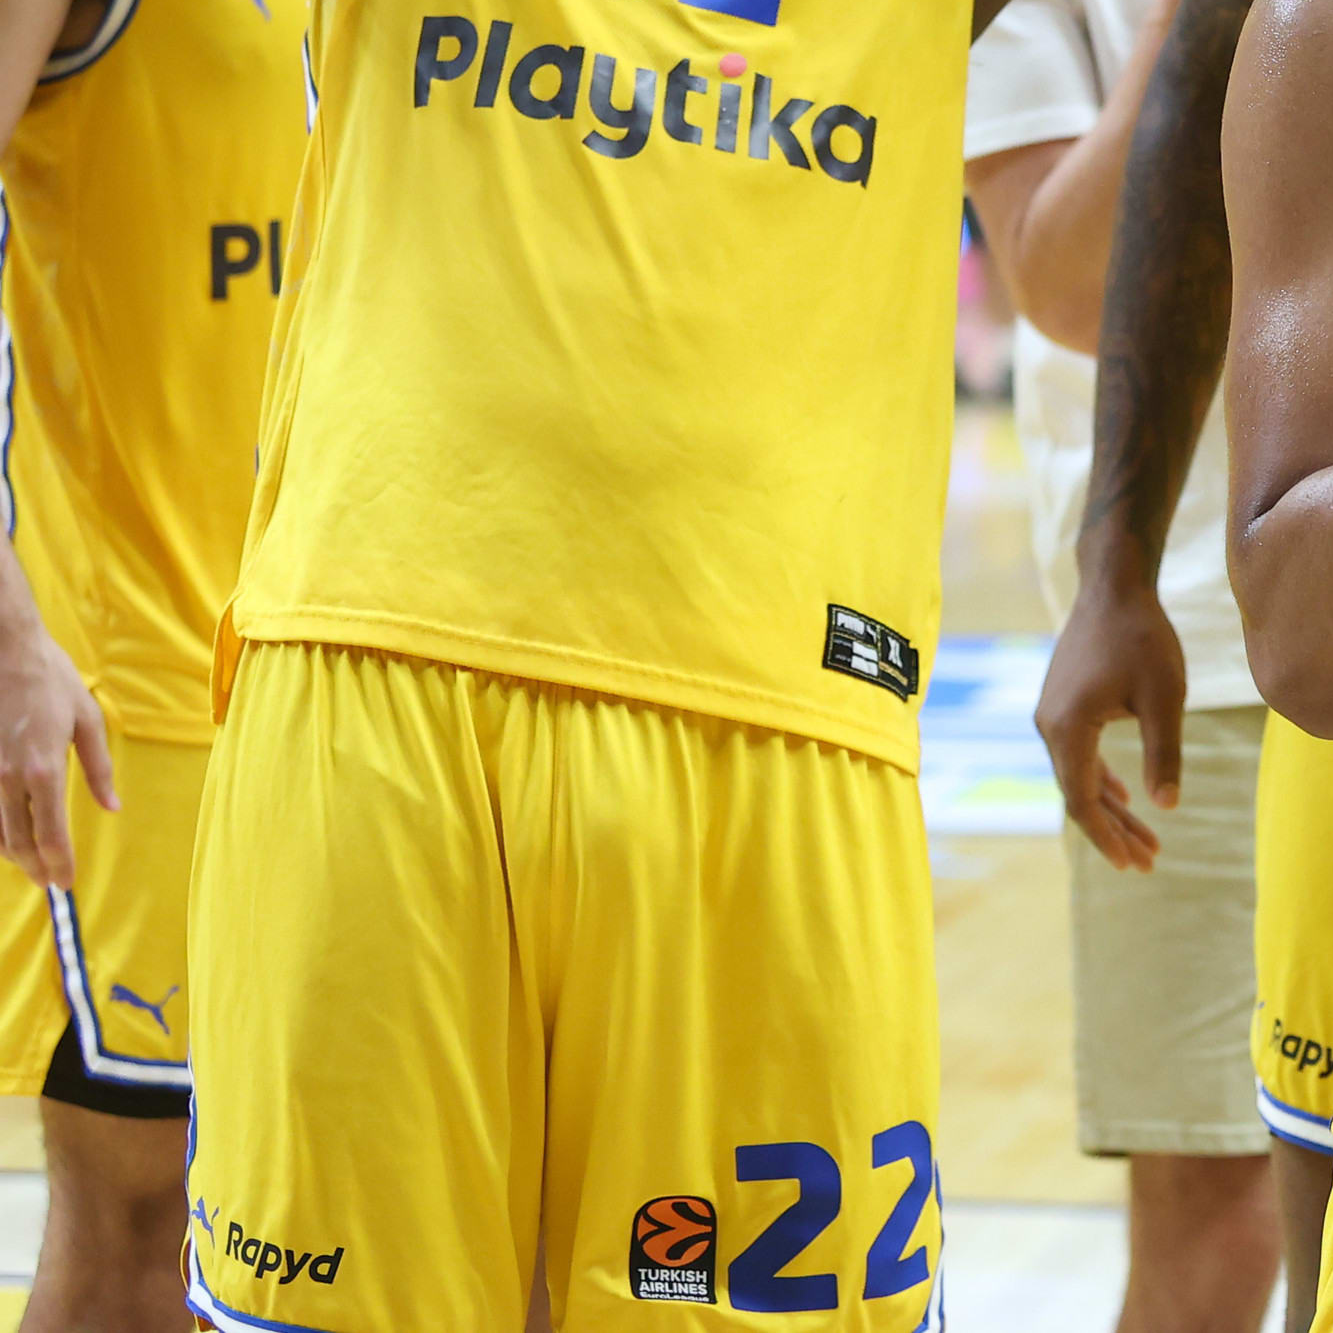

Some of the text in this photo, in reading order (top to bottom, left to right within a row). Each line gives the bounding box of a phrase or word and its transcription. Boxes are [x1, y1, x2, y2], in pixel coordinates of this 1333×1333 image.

[414, 16, 877, 188] Playtika
[728, 1120, 933, 1313] 22
[226, 1220, 345, 1285] Rapyd
[638, 1268, 707, 1283] TURKISH
[639, 1281, 708, 1295] AIRLINES
